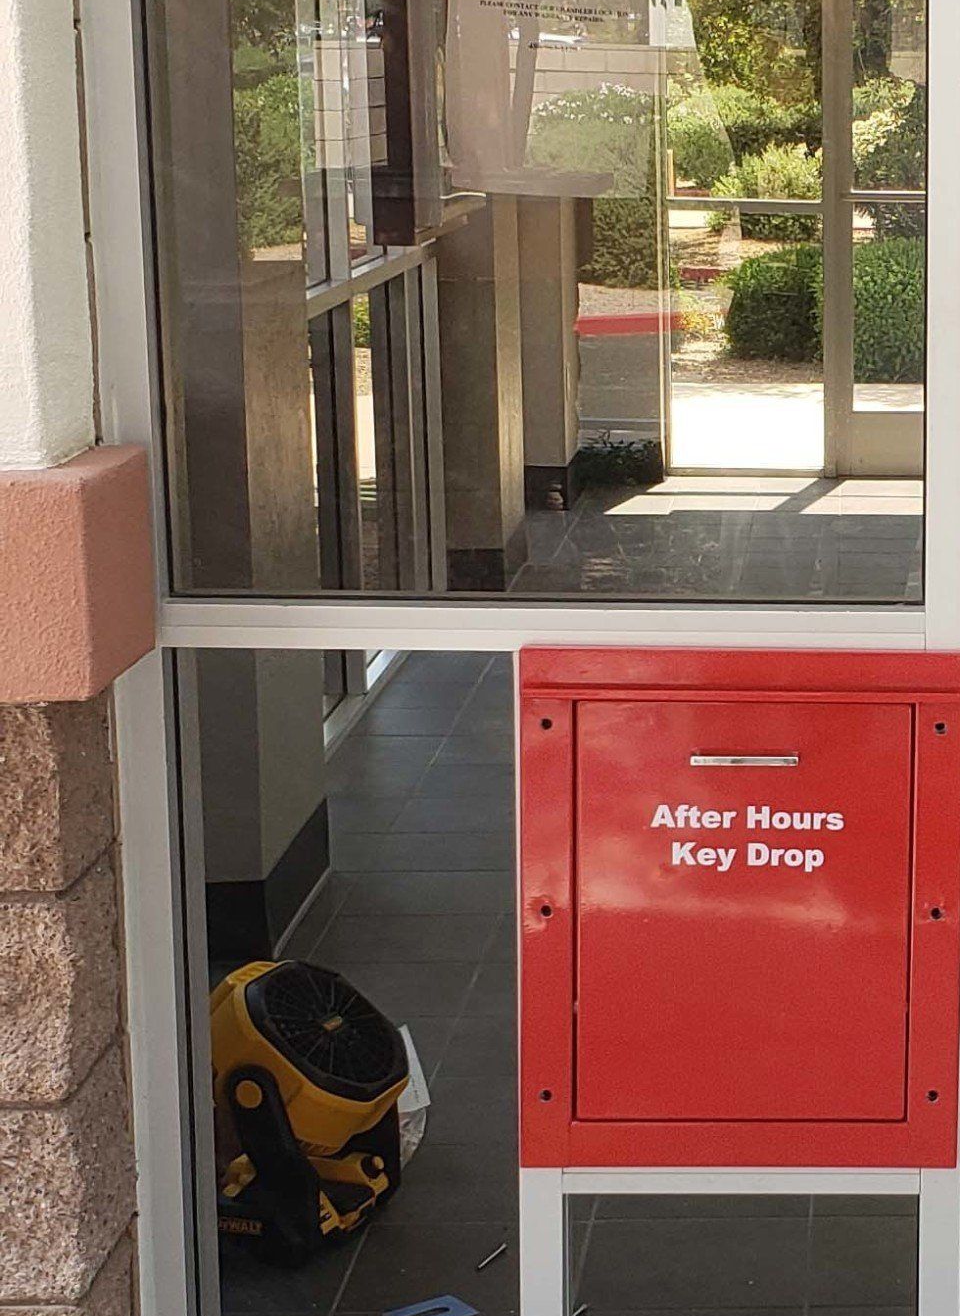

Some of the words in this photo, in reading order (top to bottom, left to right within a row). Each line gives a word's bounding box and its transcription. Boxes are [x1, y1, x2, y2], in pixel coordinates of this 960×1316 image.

[650, 804, 737, 829] After
[747, 805, 844, 831] Hours
[671, 841, 737, 872] Key
[747, 842, 825, 873] Drop
